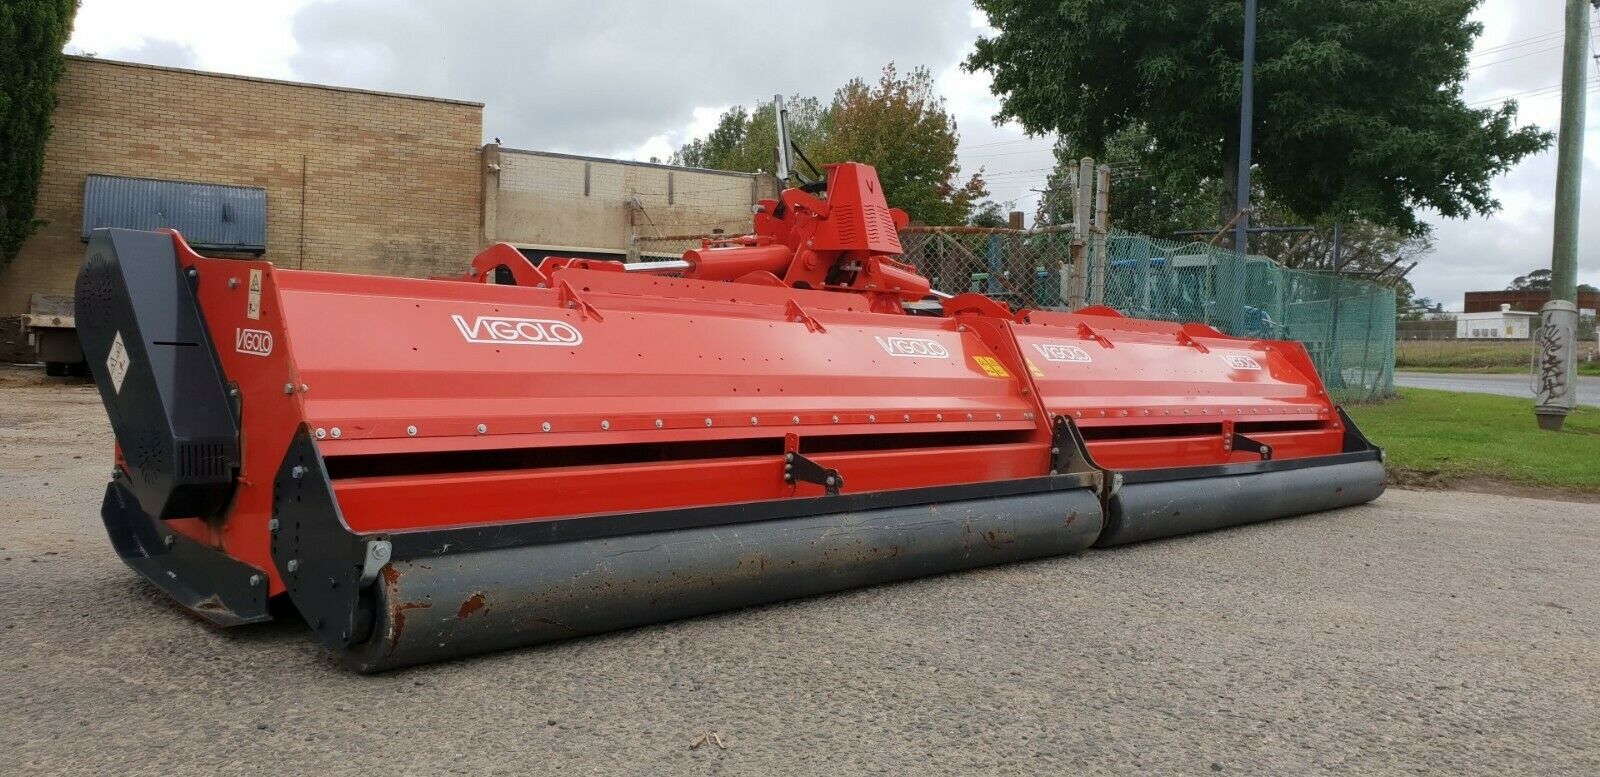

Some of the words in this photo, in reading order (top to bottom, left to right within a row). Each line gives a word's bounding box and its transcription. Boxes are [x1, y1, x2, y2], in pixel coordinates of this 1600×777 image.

[235, 327, 273, 357] VIGOLO
[451, 314, 583, 346] VIGOLO
[873, 335, 949, 359] VIGOLO
